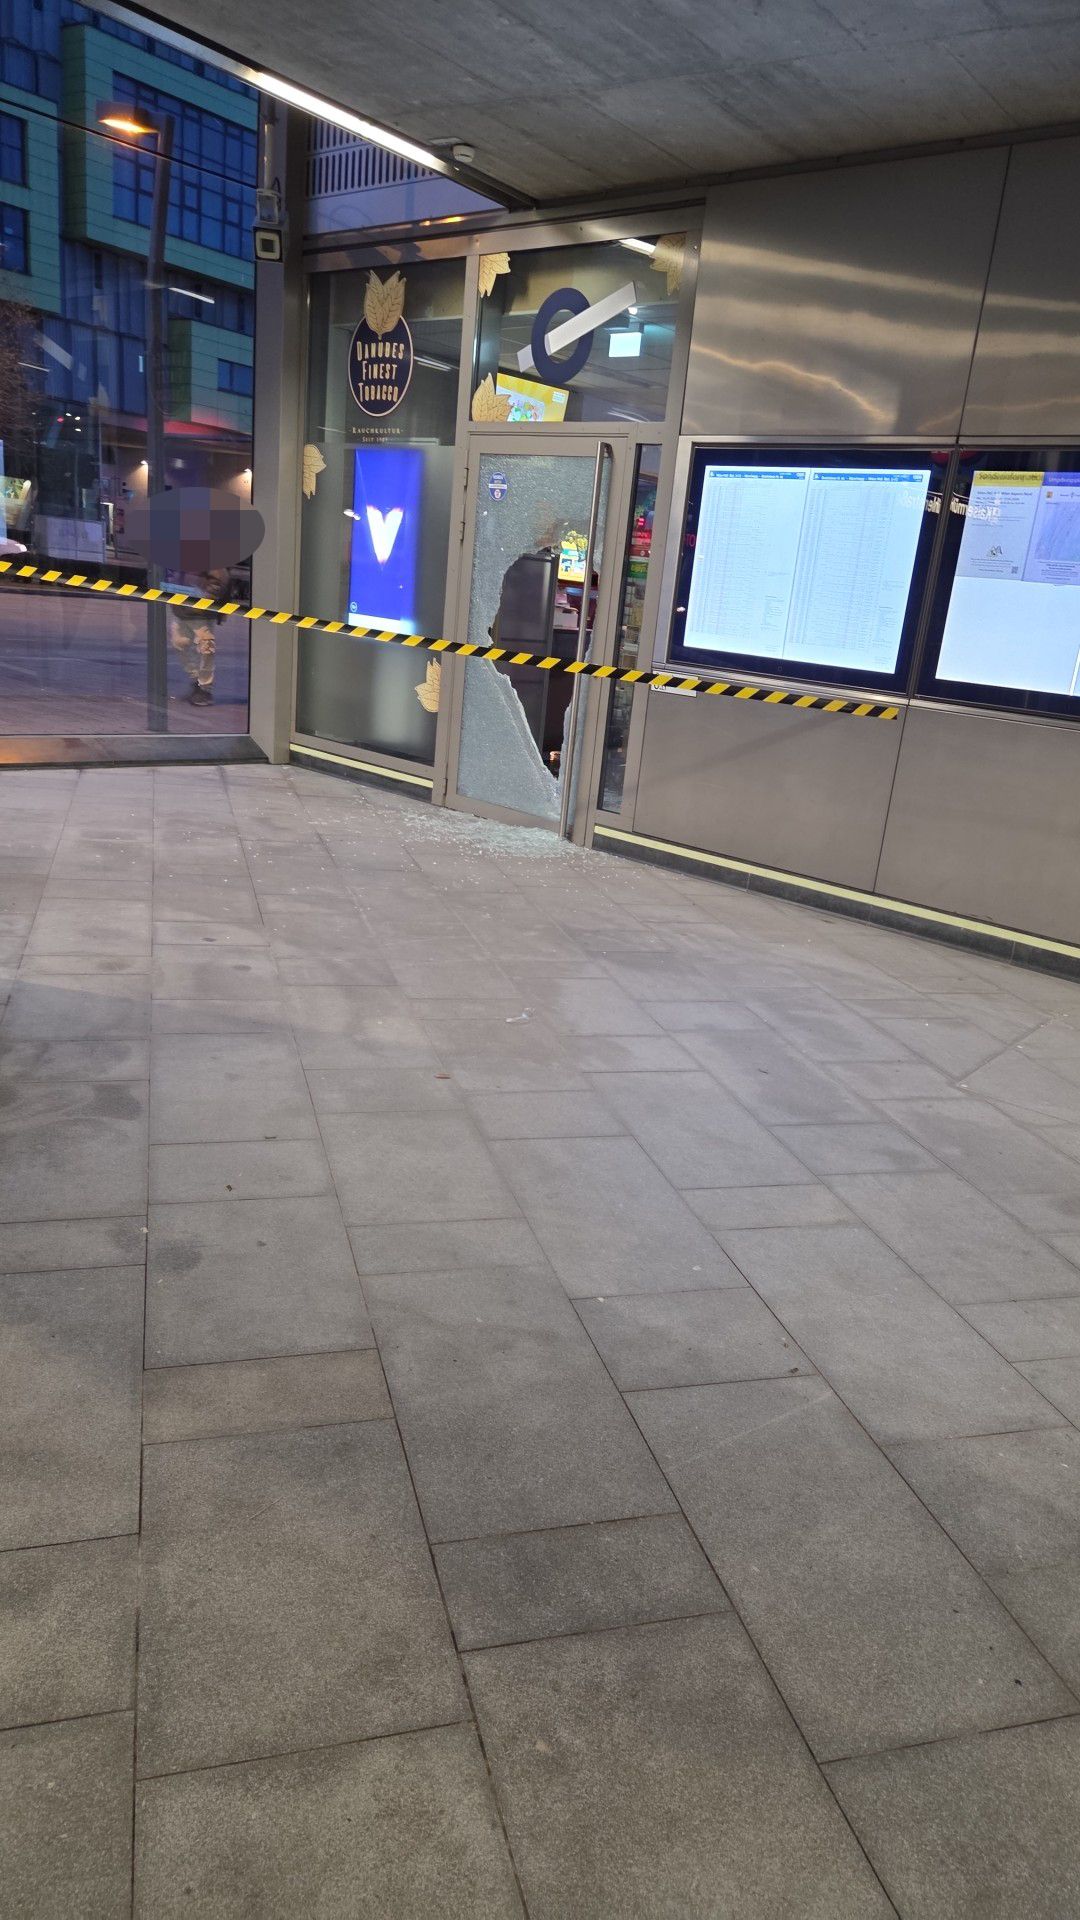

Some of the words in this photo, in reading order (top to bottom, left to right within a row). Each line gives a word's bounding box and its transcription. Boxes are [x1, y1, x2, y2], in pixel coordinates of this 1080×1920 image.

[356, 341, 405, 361] DANUBES
[362, 360, 398, 380] FINEST
[357, 382, 399, 402] TOBACCO
